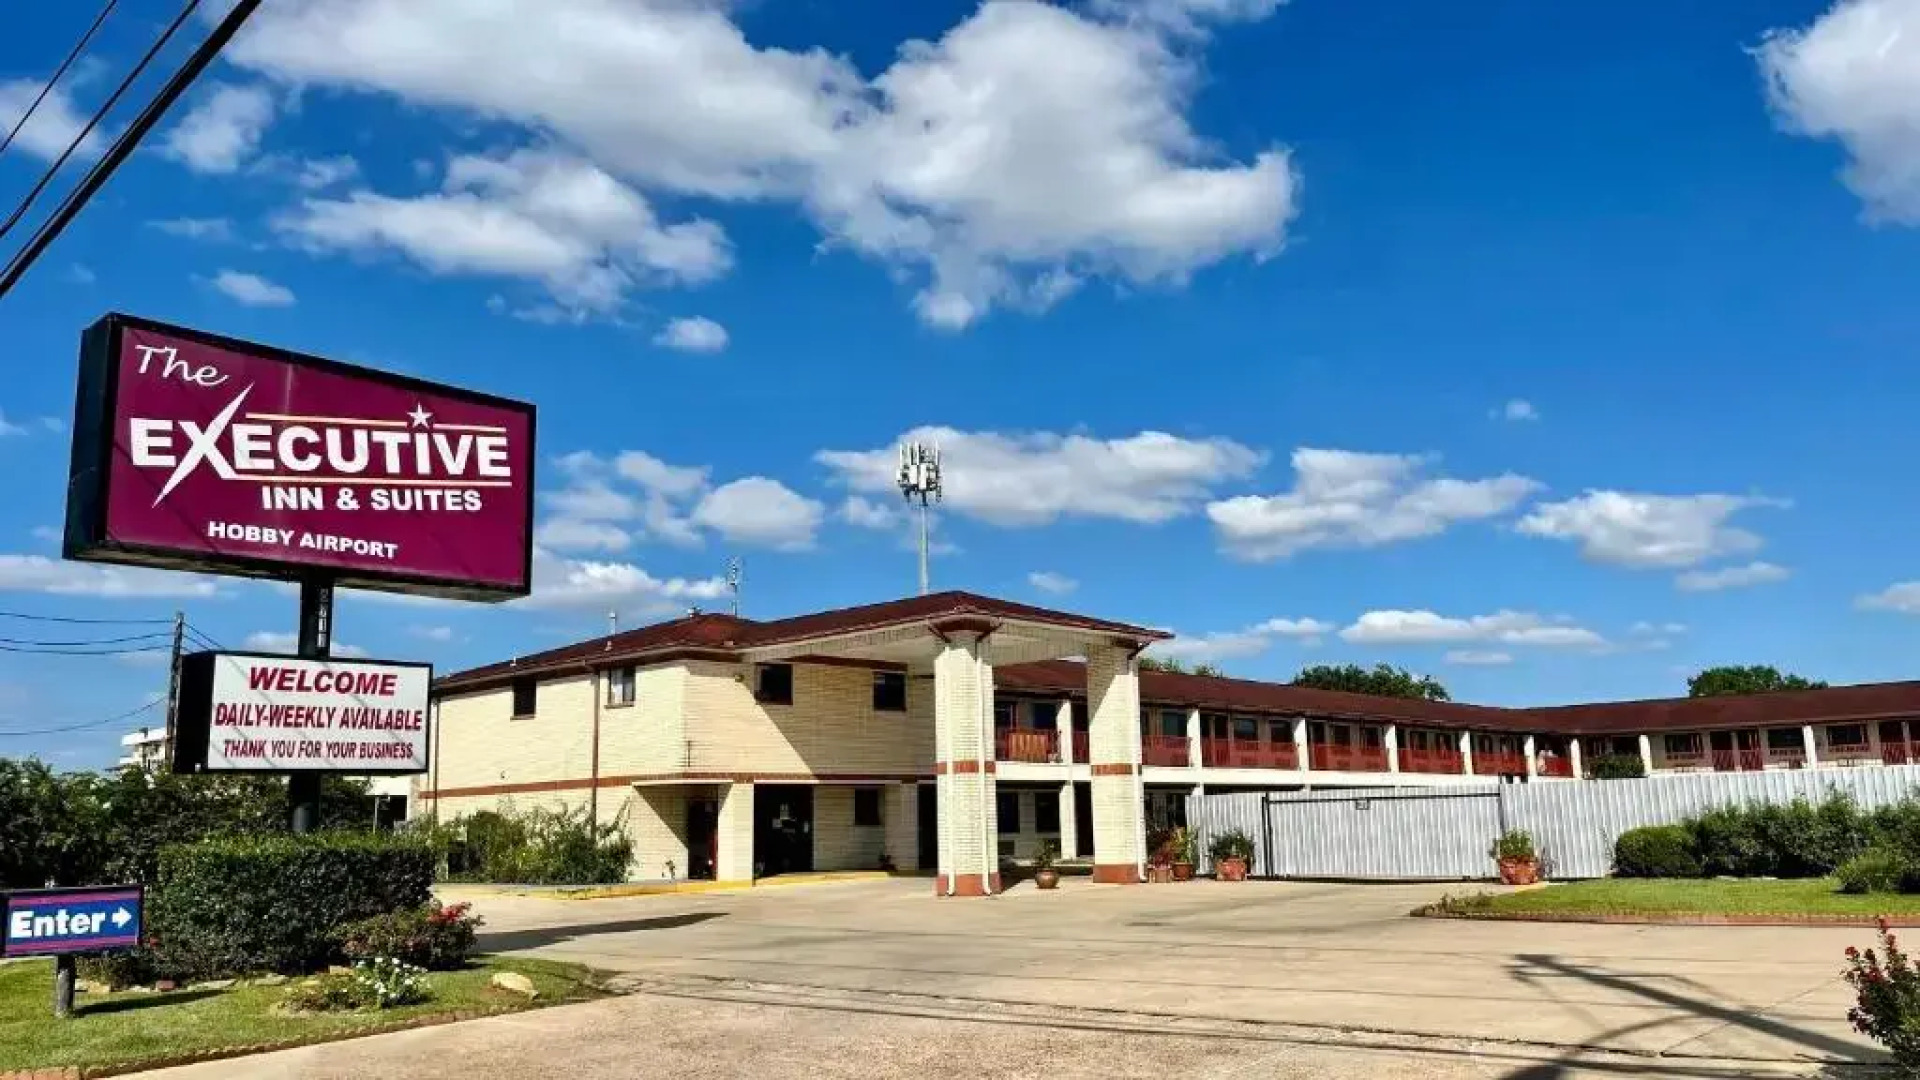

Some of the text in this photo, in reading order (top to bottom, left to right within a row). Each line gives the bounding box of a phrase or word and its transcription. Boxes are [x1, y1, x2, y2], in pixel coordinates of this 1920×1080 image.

[135, 345, 228, 386] The
[130, 383, 512, 508] EXECUTIVE
[263, 486, 482, 511] INN & SUITES
[208, 521, 398, 559] HOBBY AIRPORT
[250, 667, 397, 696] WELCOME
[215, 703, 421, 730] DAILY-WEEKLY AVAILABLE
[224, 739, 413, 759] THANK YOU FOR YOUR BUSINESS
[11, 909, 106, 938] Enter
